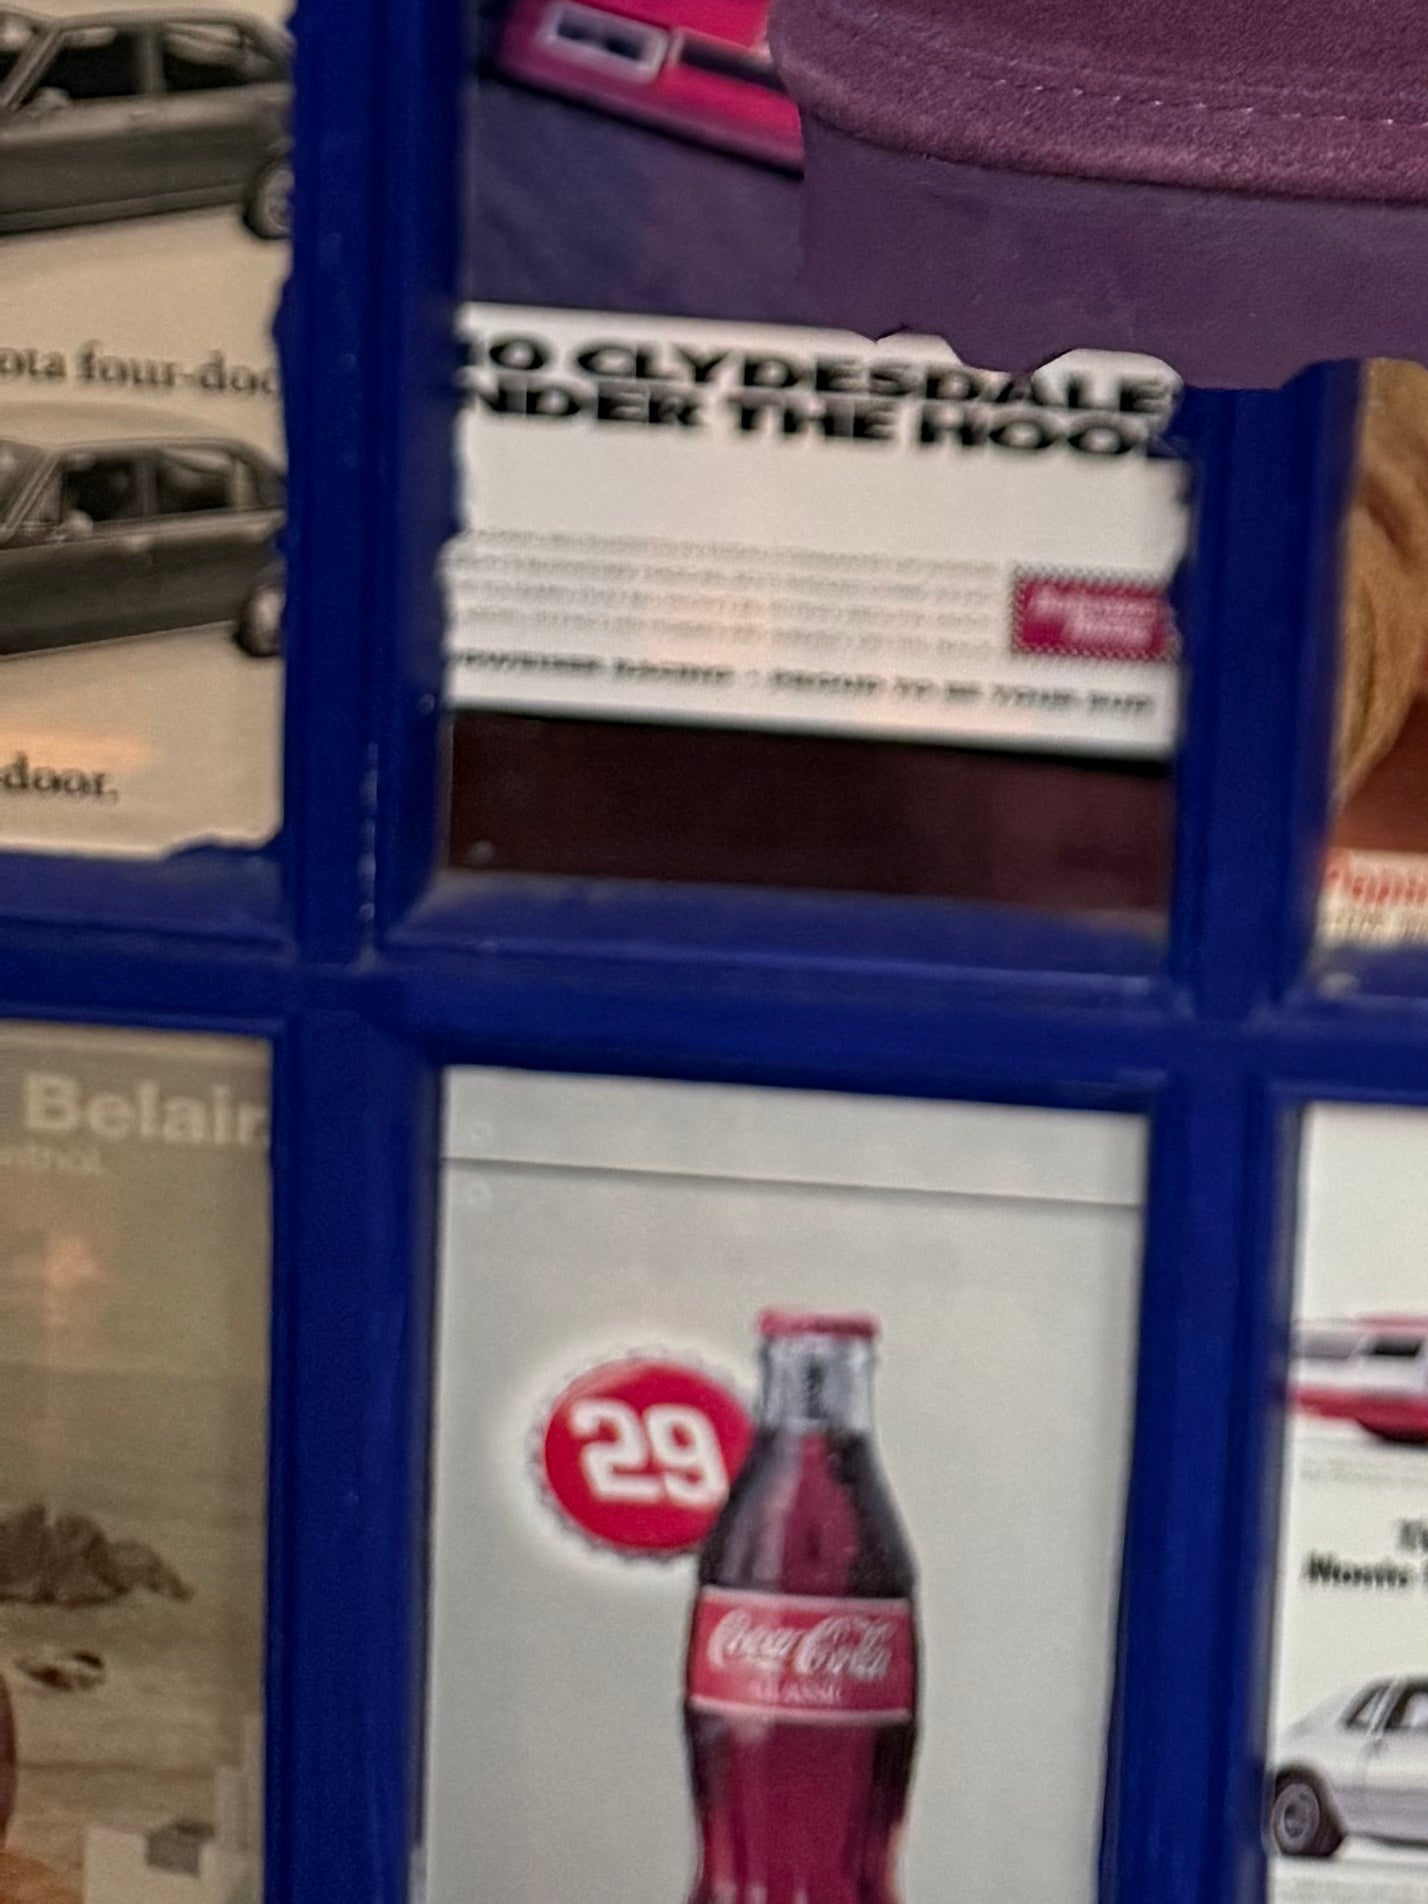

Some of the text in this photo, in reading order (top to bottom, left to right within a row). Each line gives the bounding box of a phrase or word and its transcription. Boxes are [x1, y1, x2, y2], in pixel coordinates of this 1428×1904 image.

[727, 390, 896, 442] THE
[917, 400, 1165, 457] HOO
[569, 1397, 732, 1509] 29
[1302, 1549, 1409, 1587] Monte
